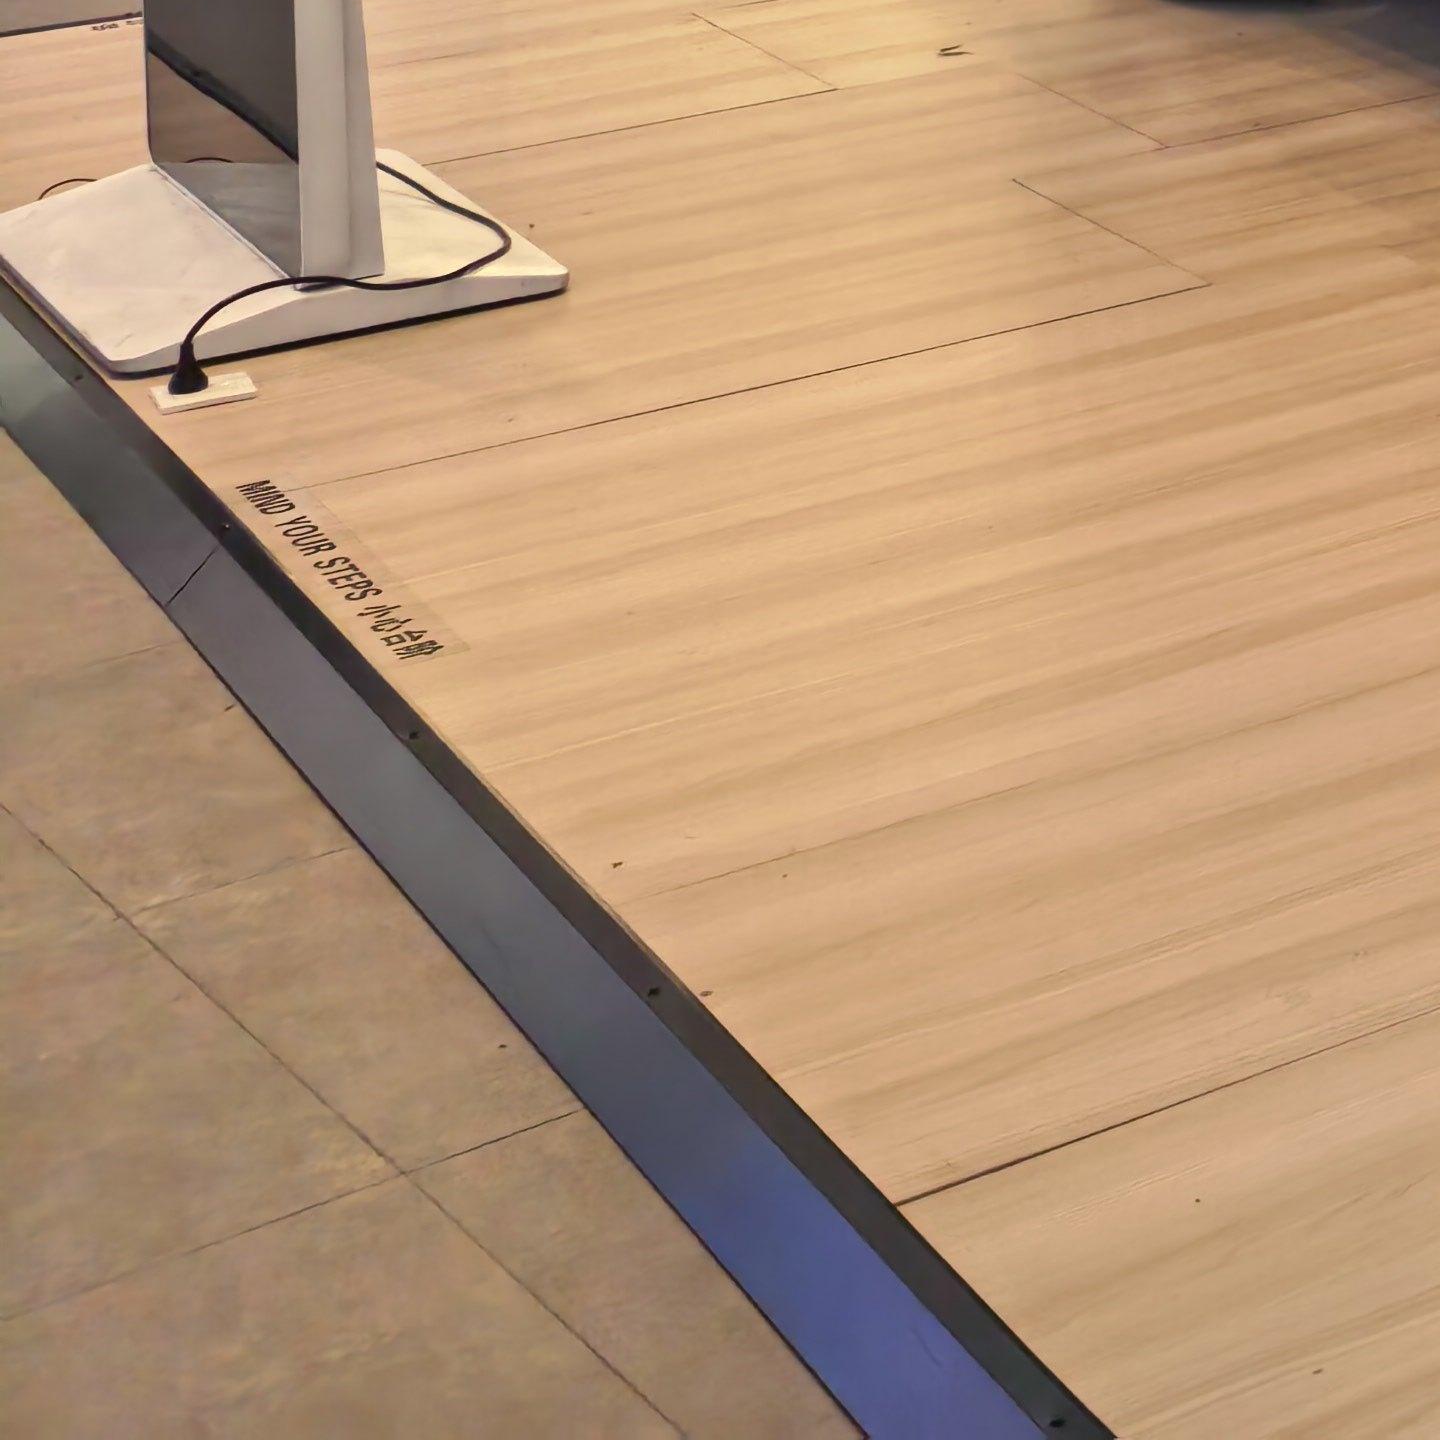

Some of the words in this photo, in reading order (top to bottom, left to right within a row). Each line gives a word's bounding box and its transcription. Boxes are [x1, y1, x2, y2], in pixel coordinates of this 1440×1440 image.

[235, 479, 295, 516] MIND
[273, 514, 337, 558] YOUR
[312, 555, 384, 603] STEPS
